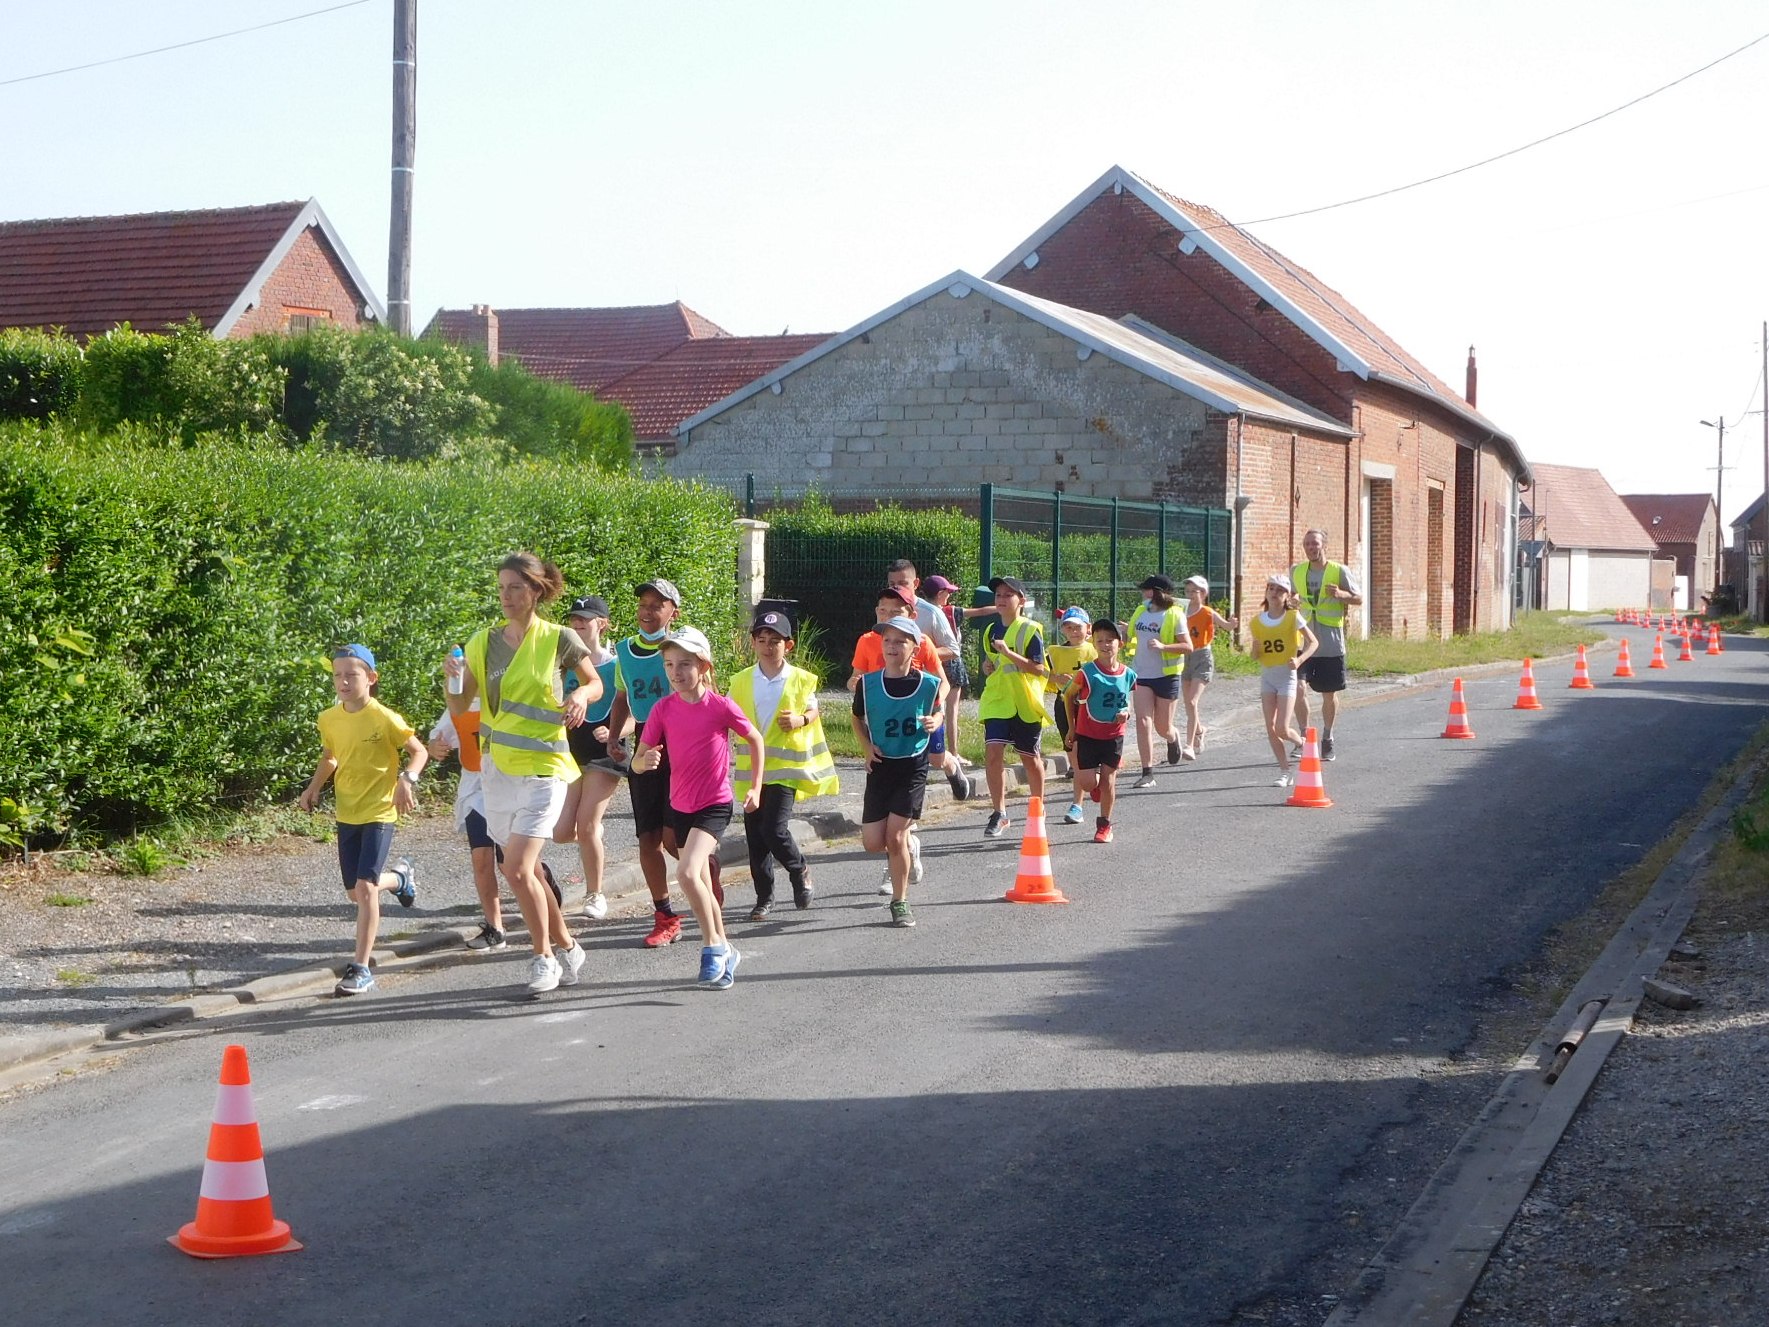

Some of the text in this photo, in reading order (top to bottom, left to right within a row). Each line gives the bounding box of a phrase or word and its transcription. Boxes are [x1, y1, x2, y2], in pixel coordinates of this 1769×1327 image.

[1263, 639, 1285, 654] 26
[632, 676, 664, 700] 24
[1103, 692, 1128, 709] 23
[885, 716, 917, 738] 26
